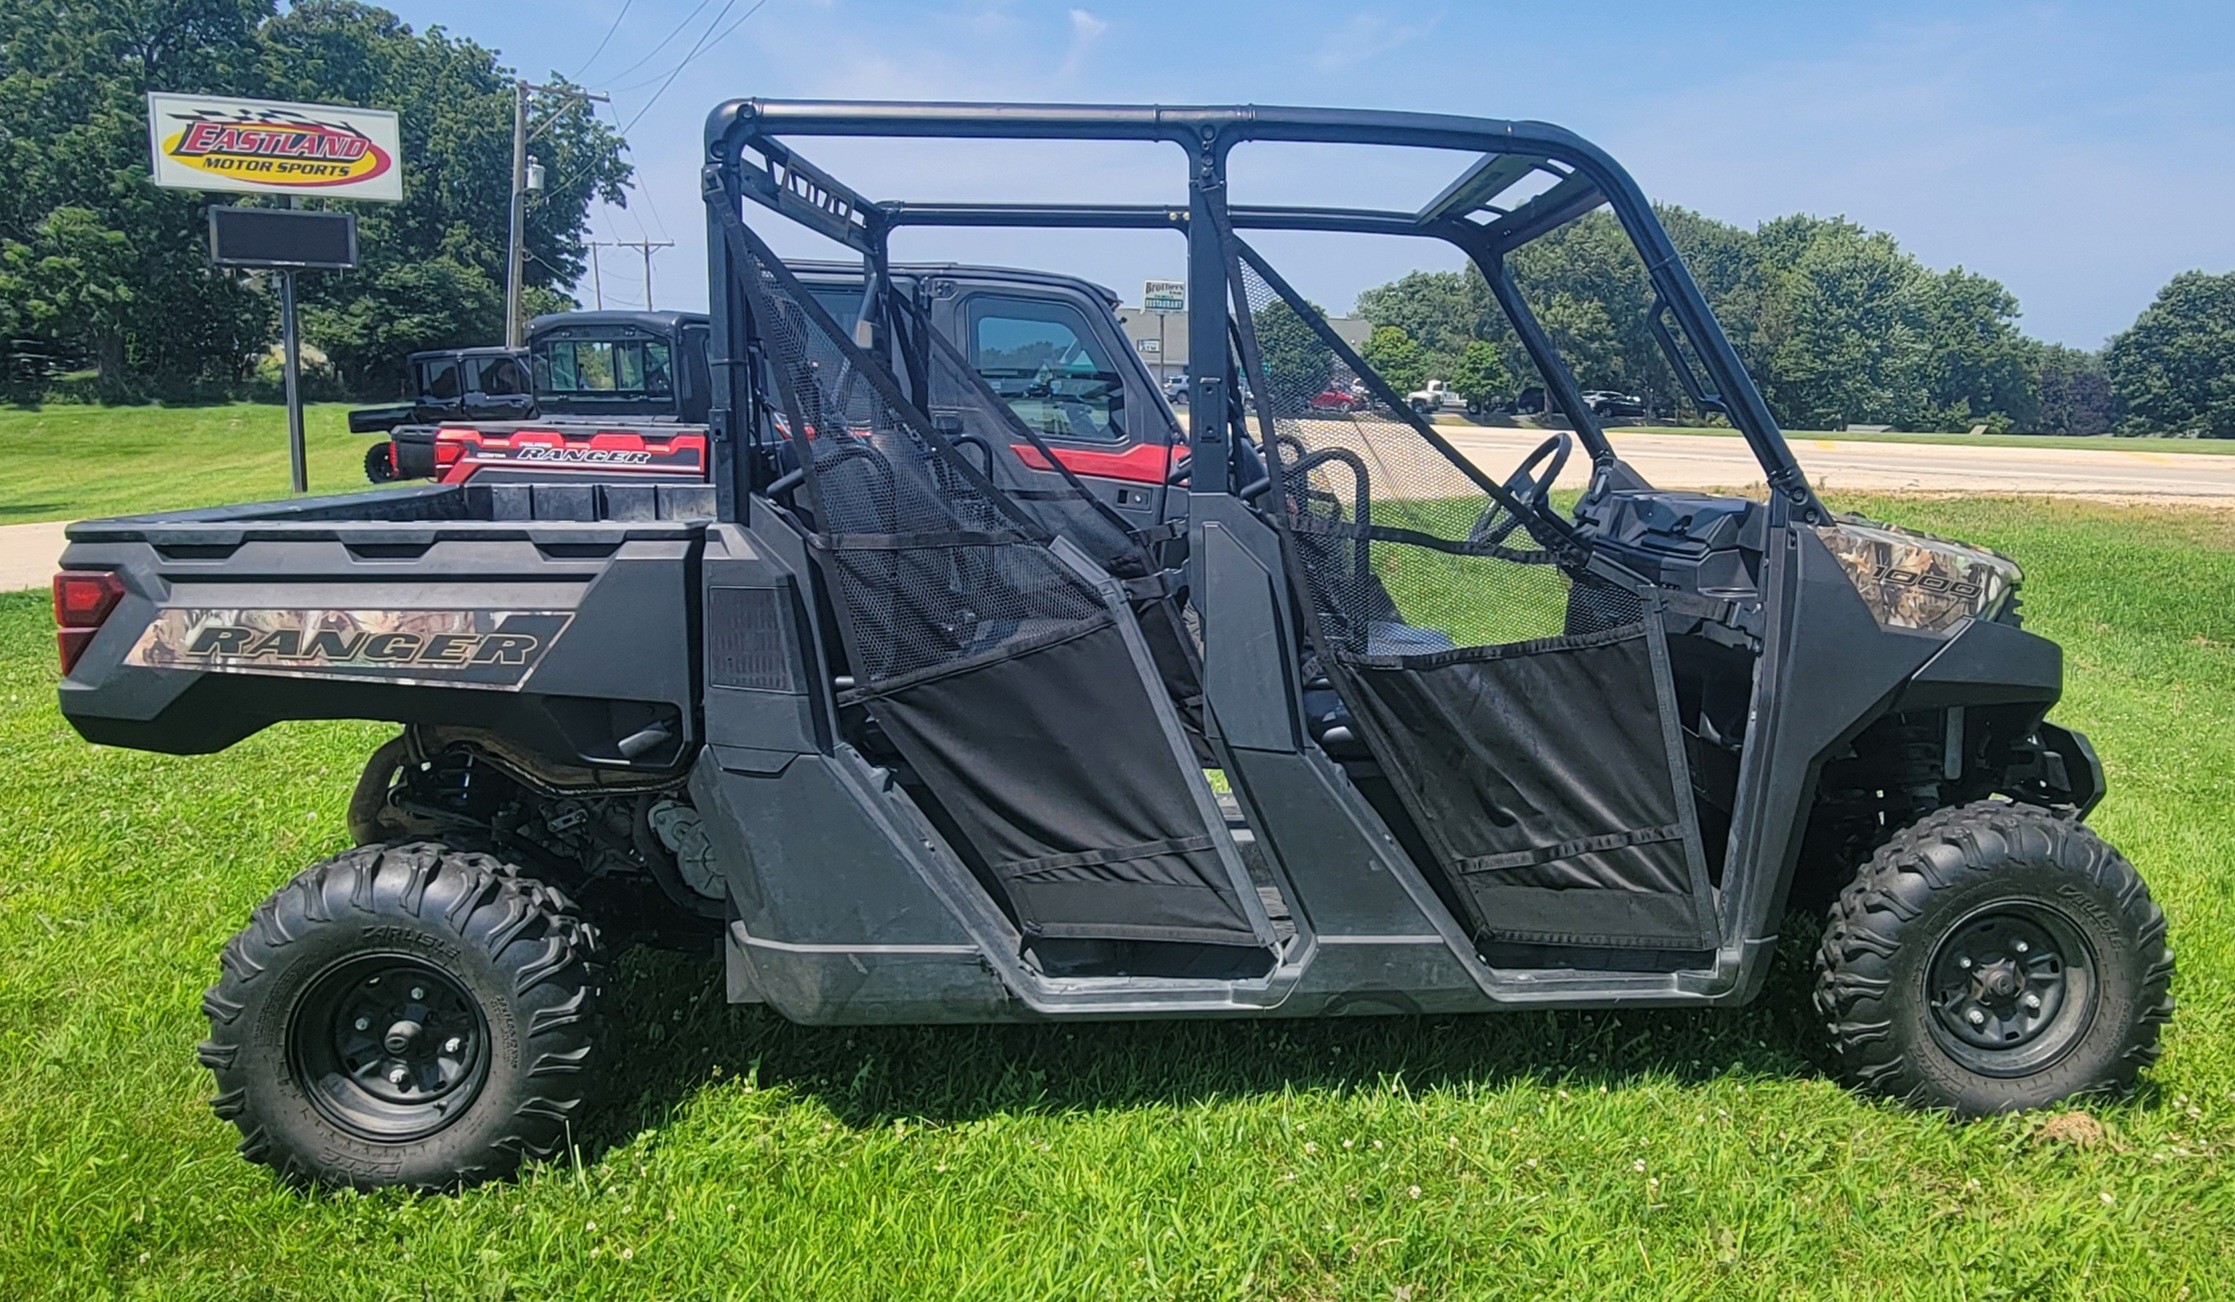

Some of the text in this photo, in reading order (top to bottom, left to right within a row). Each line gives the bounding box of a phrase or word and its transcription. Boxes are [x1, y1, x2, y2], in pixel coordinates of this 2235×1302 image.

[180, 121, 372, 160] EASTLAND
[202, 157, 351, 177] MOTOR SPORTS
[1145, 281, 1184, 294] Brothers
[517, 447, 652, 464] RANGER
[1872, 565, 1983, 599] 1000
[186, 626, 540, 666] RANGER
